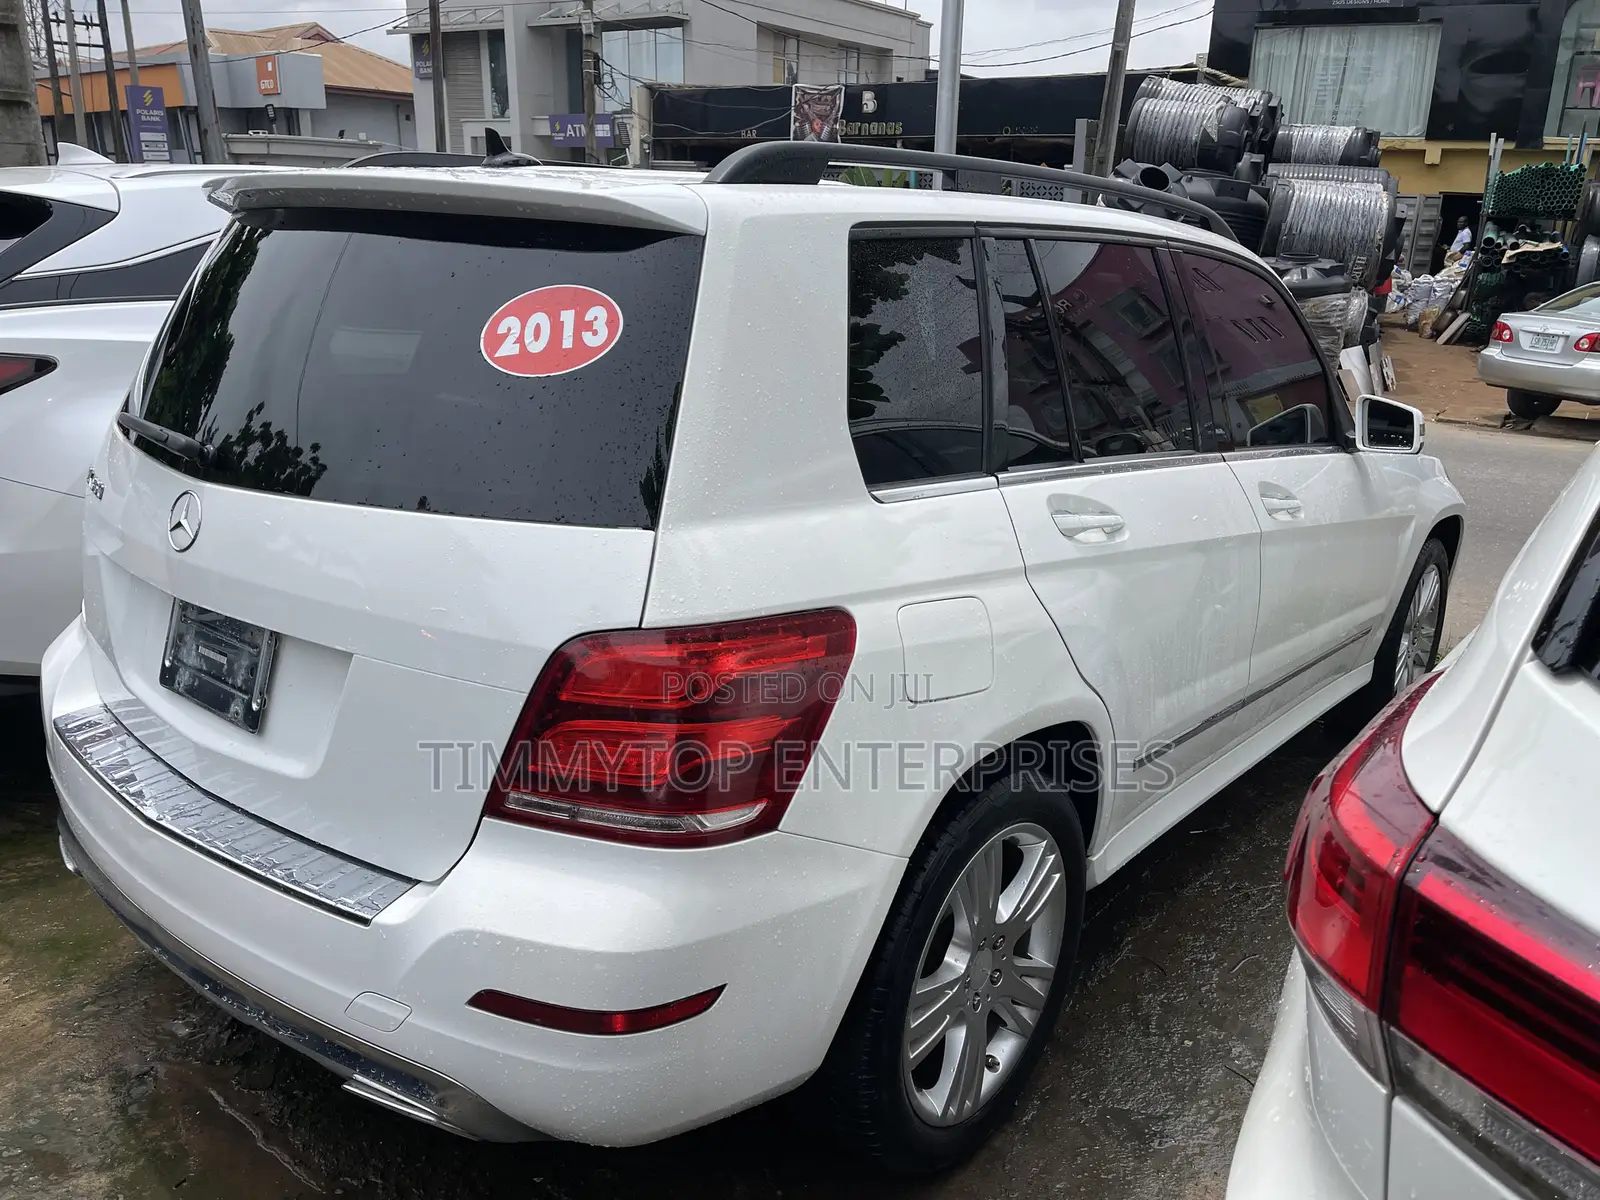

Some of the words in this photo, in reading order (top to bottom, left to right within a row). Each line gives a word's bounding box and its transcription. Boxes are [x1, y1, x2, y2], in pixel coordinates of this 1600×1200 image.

[862, 90, 878, 113] B
[839, 119, 903, 136] Barnanas
[494, 305, 609, 358] 2013
